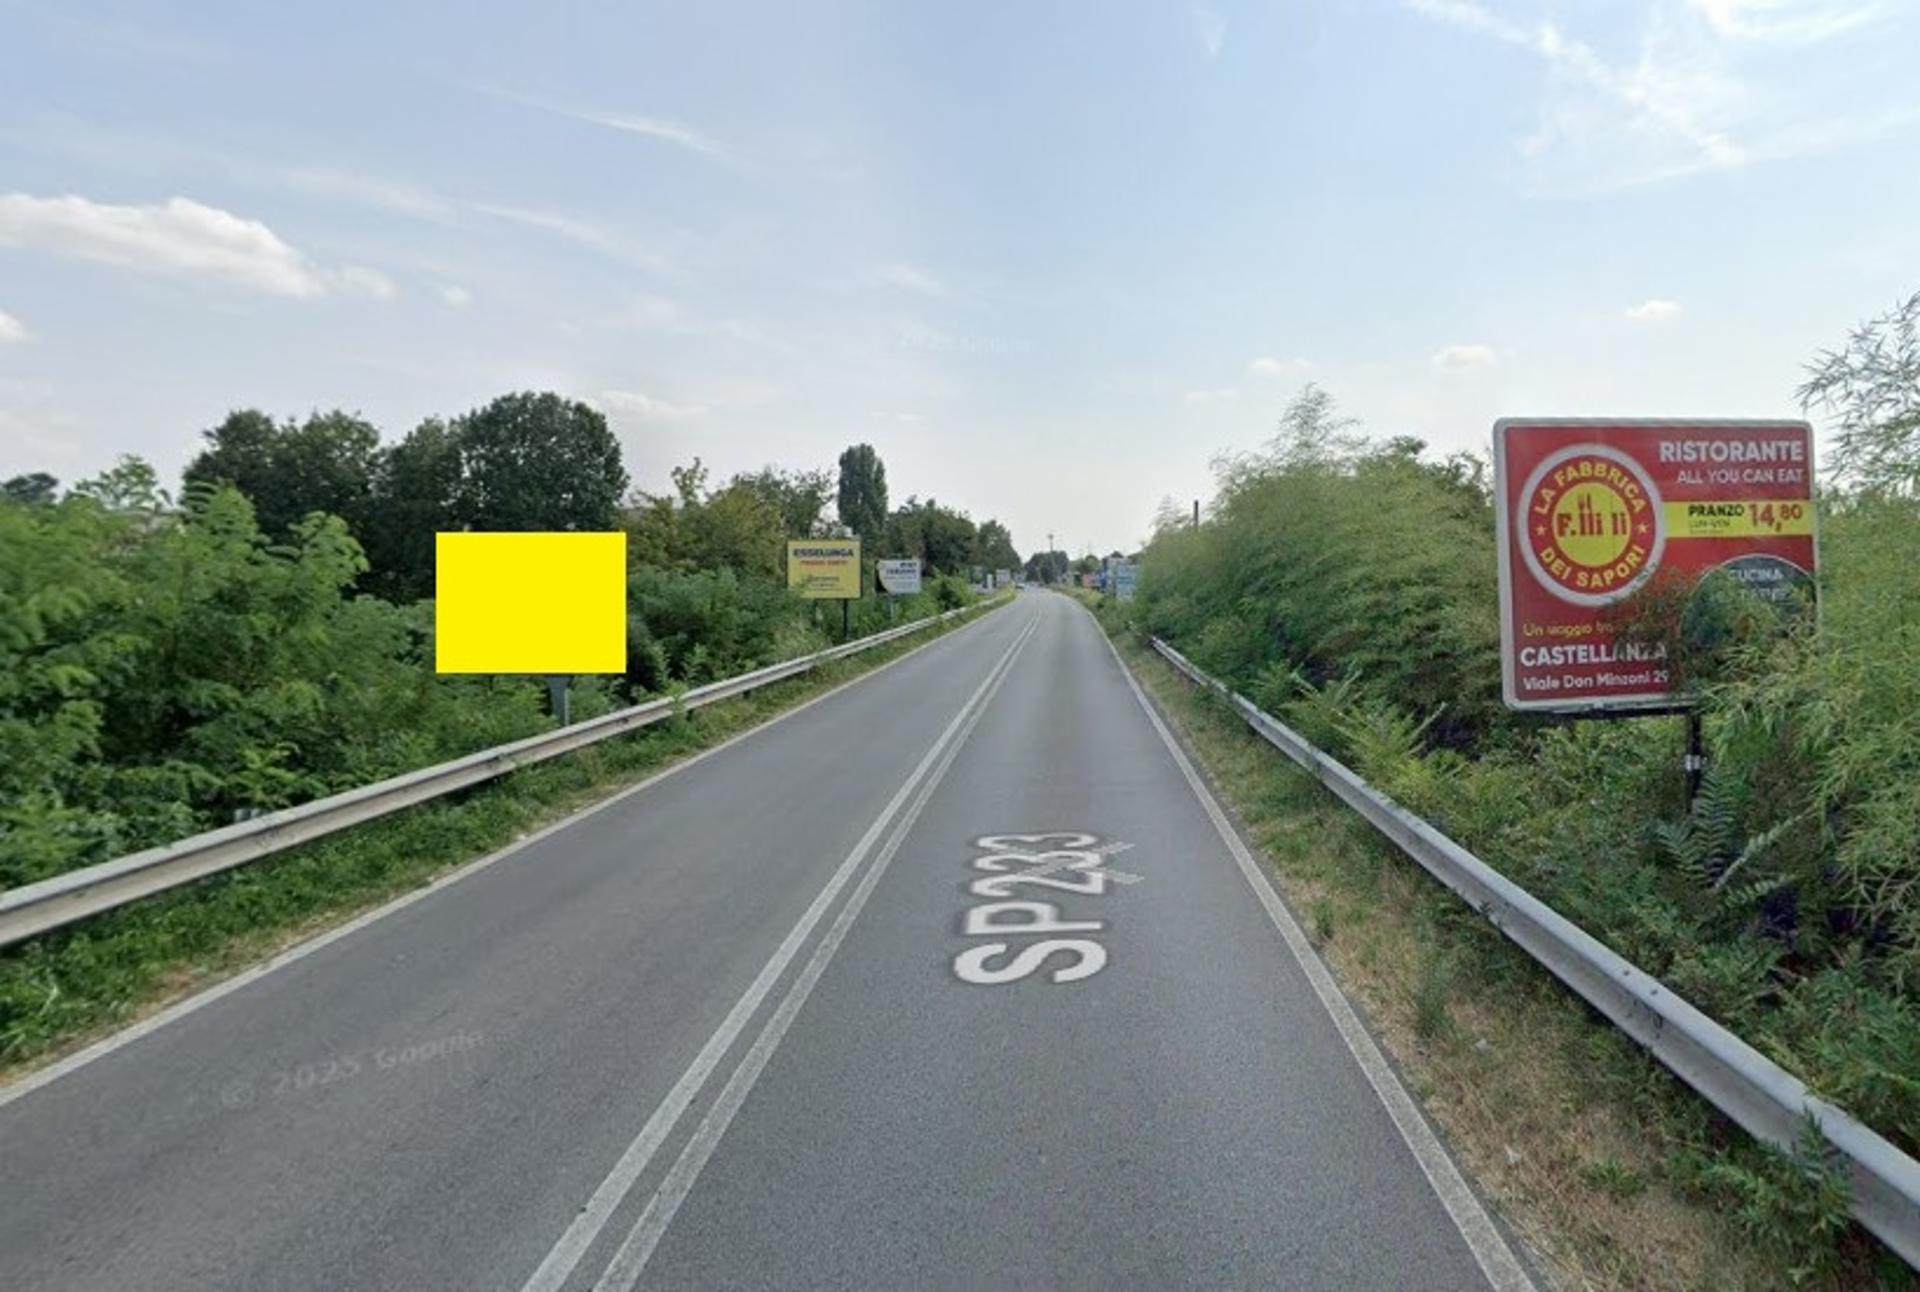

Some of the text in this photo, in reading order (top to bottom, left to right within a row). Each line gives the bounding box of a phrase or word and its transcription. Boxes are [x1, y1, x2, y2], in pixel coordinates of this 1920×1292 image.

[1659, 441, 1803, 462] RISTORANTE
[1534, 461, 1647, 515] LA FABBRICA
[1678, 468, 1804, 484] ALL YOU CAN EAT
[1688, 503, 1804, 532] PRANZO 14,80
[1540, 544, 1645, 588] DEI SAPORI
[1523, 623, 1544, 637] Un
[1523, 675, 1560, 691] Viale
[1563, 674, 1593, 688] Don
[1596, 671, 1650, 686] Minzoni
[954, 832, 1107, 984] SP233
